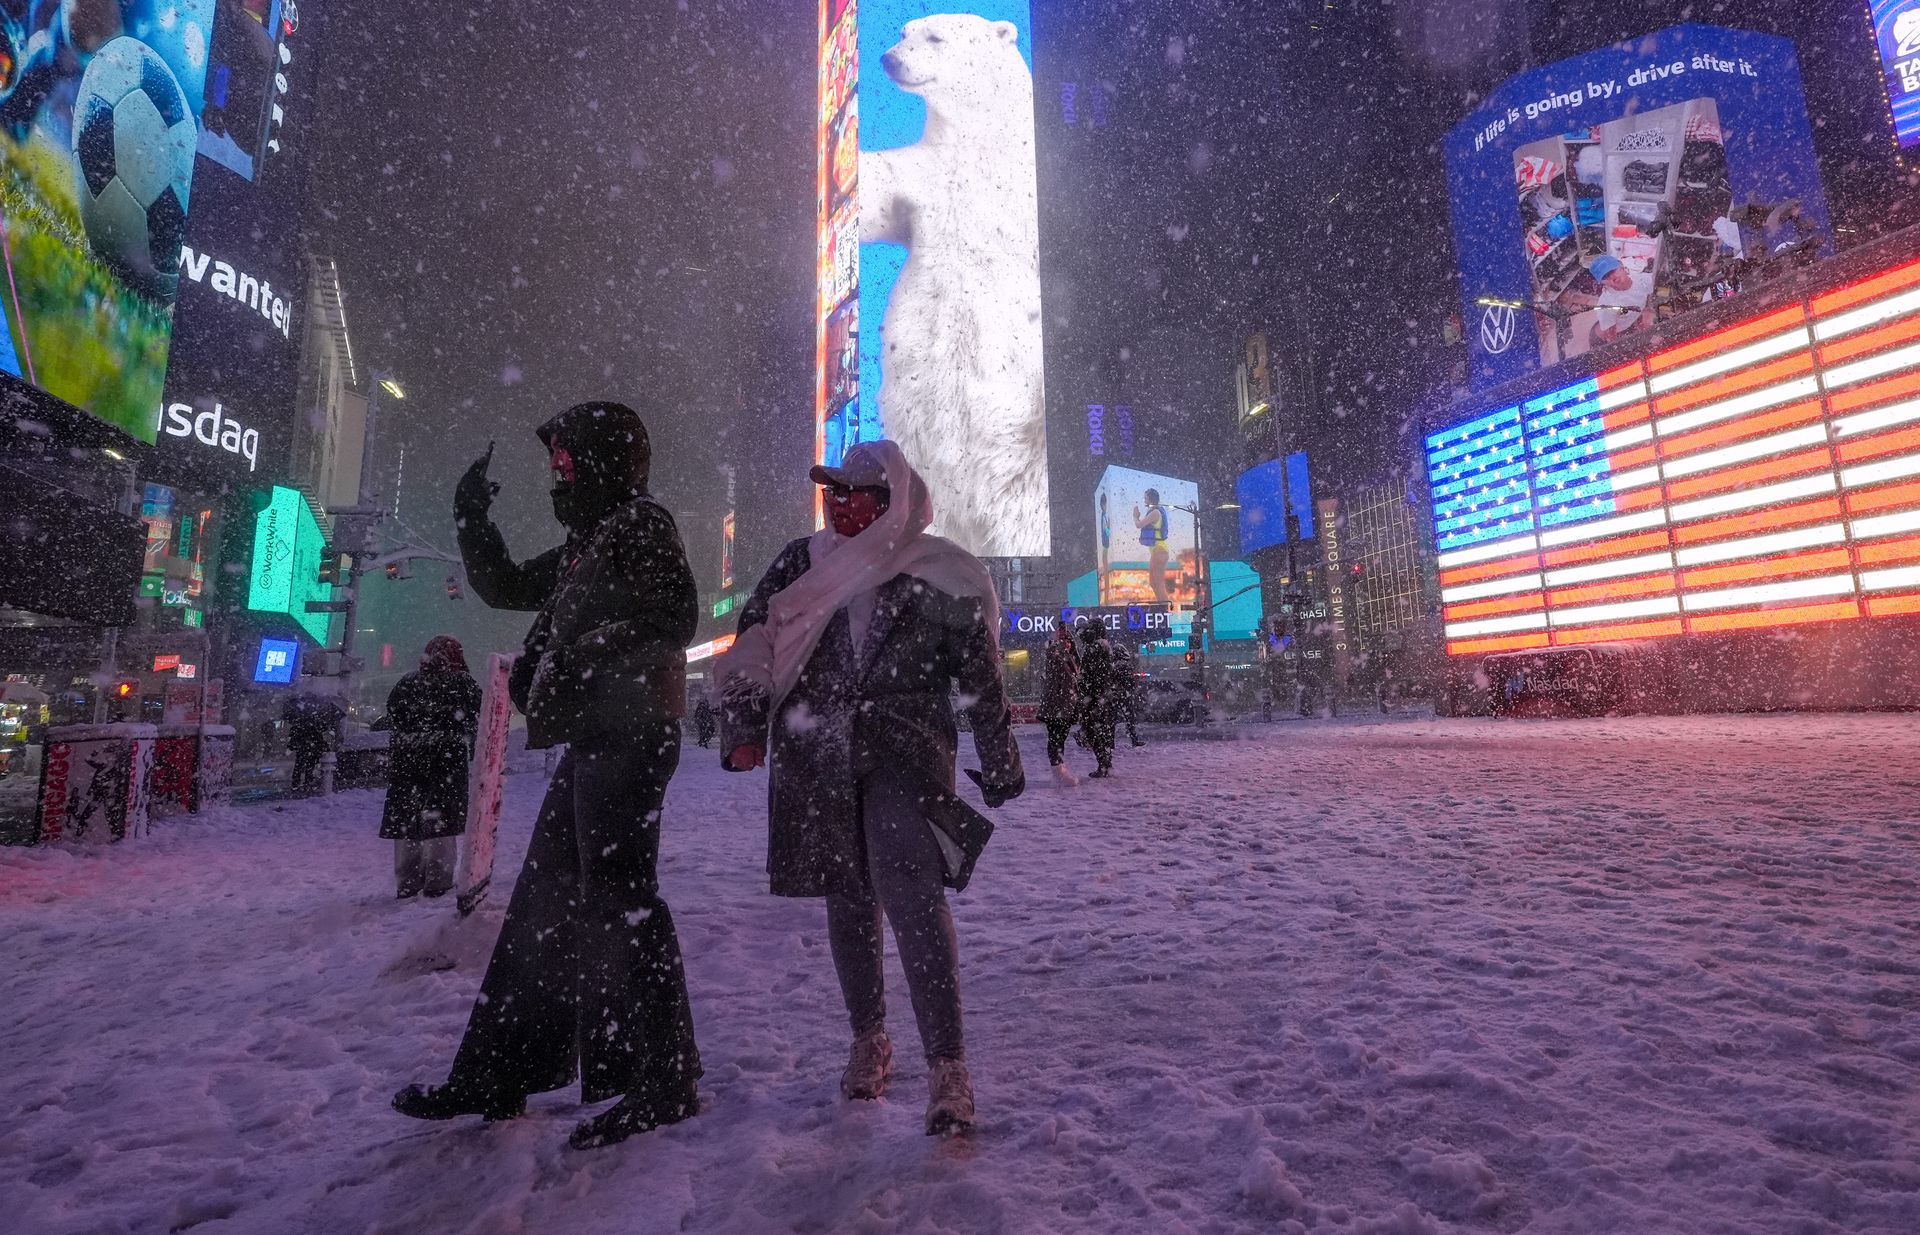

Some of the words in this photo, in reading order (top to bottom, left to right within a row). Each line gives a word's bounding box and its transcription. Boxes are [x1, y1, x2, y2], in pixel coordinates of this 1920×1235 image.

[1474, 135, 1485, 152] If
[1485, 119, 1506, 143] life
[1507, 106, 1520, 125] is
[1525, 87, 1582, 120] going
[1587, 78, 1622, 100] by,
[1627, 61, 1685, 87] drive
[1691, 54, 1736, 74] after
[1738, 58, 1758, 77] it.
[157, 402, 259, 472] sdaq
[263, 508, 277, 572] WorkWhile
[1325, 511, 1340, 571] SQUARE
[1007, 608, 1055, 633] YORK
[1061, 607, 1120, 631] POCE
[1128, 606, 1172, 632] DEPT
[1336, 642, 1347, 651] 3
